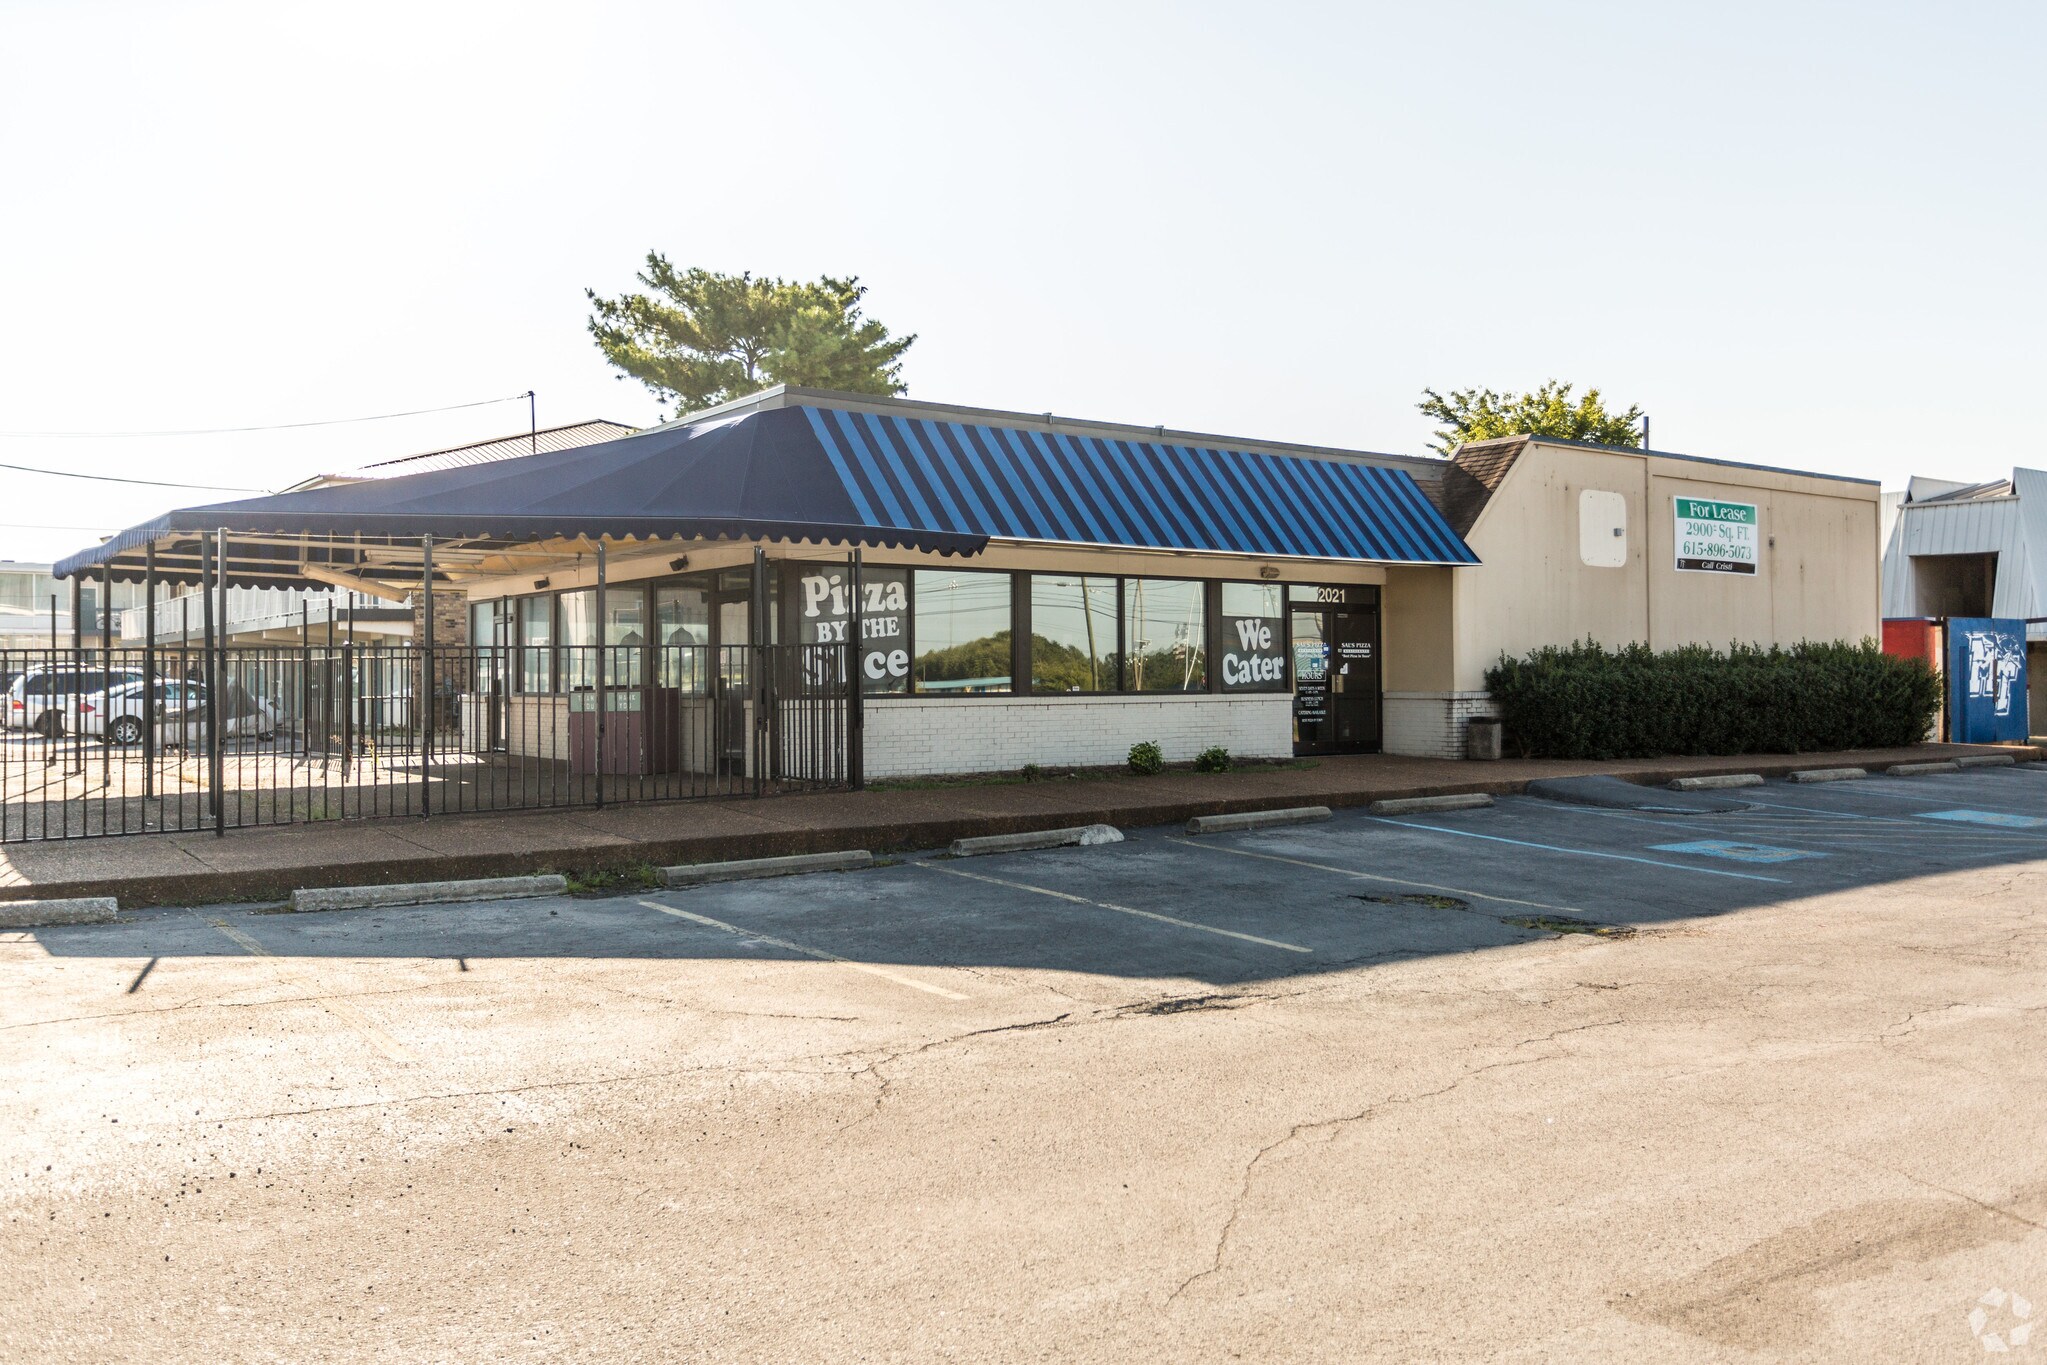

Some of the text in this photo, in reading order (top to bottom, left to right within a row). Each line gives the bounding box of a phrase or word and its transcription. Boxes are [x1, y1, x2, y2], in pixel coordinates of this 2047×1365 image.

[1689, 502, 1747, 521] For Lease
[1719, 524, 1733, 542] Sq.
[1702, 561, 1714, 569] Call
[1318, 588, 1345, 603] 2021
[816, 621, 847, 642] BY
[1235, 619, 1271, 651] We
[1222, 653, 1284, 685] Cater
